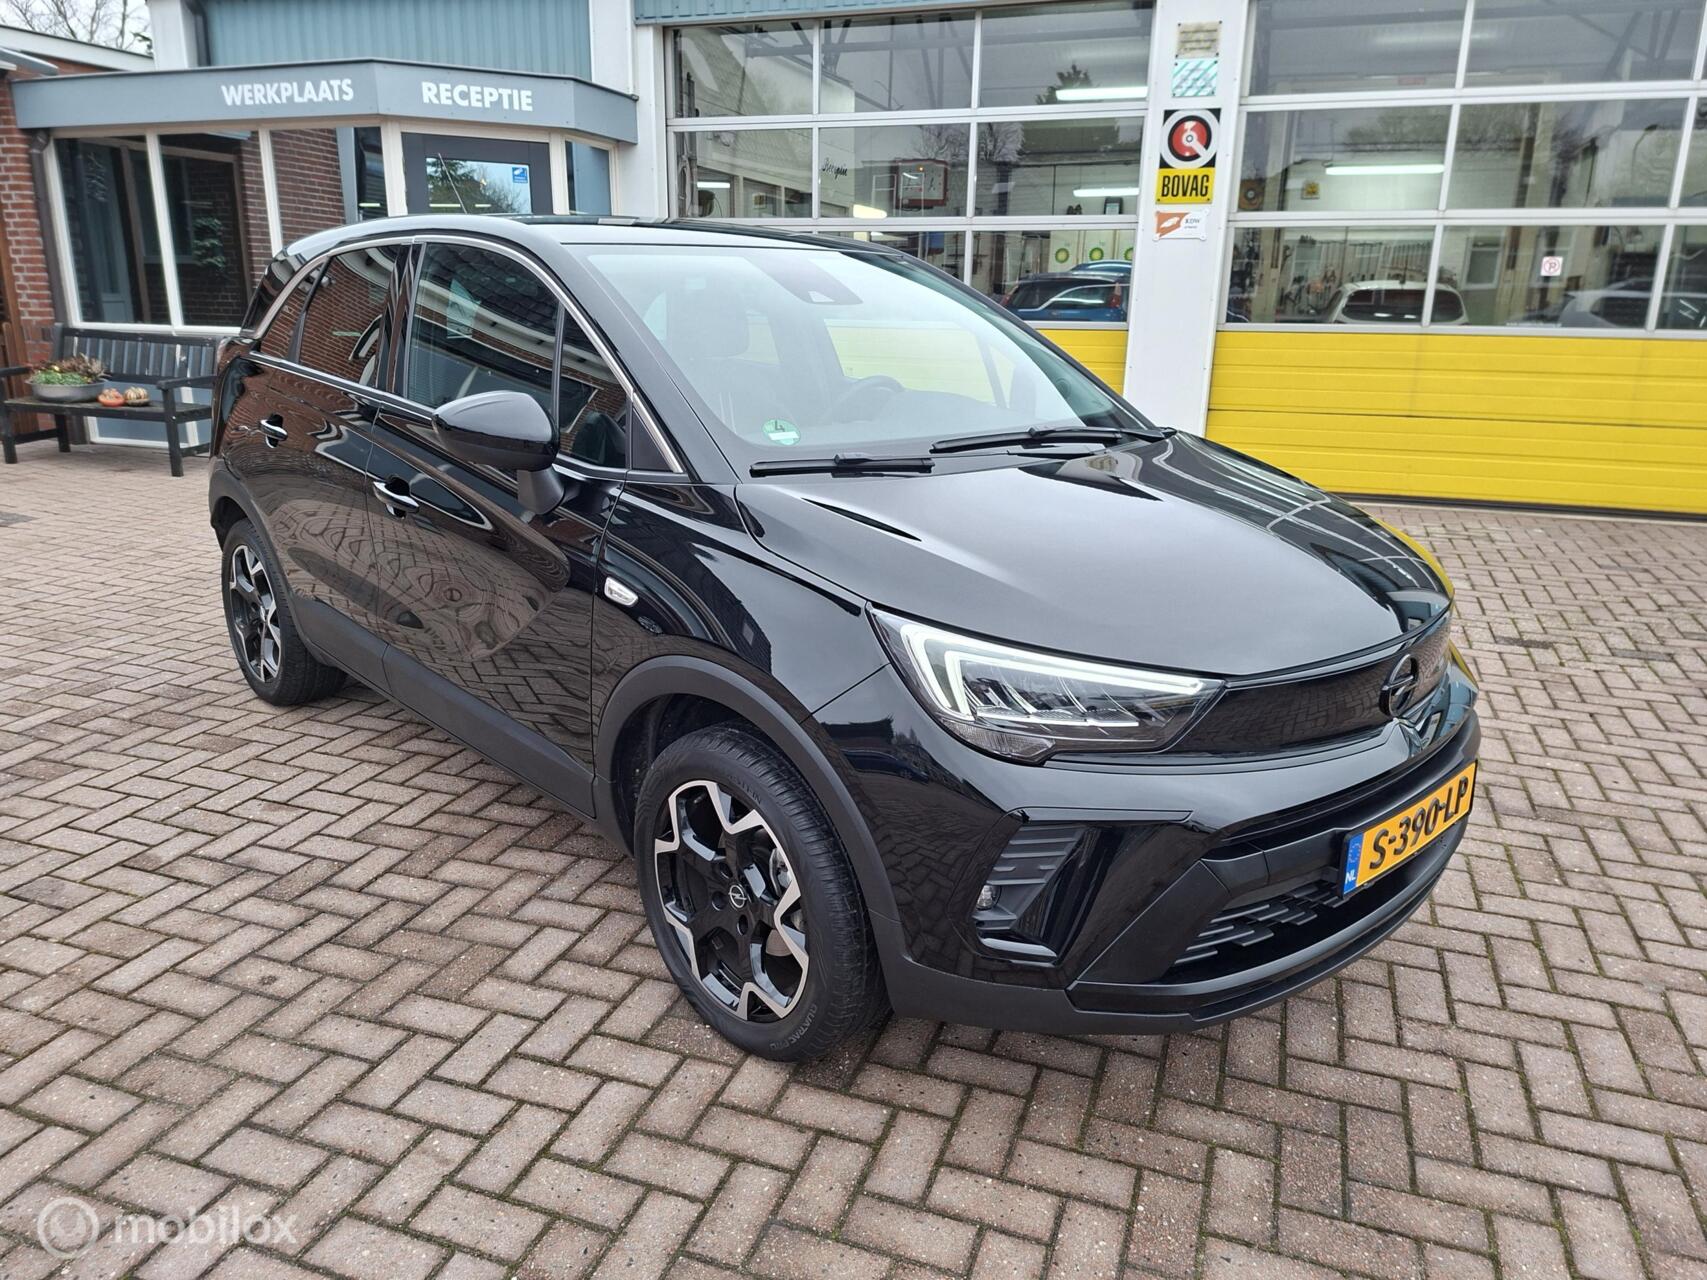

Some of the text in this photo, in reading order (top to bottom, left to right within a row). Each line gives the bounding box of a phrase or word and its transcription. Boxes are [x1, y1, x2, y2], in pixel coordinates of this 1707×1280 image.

[221, 78, 354, 106] WERKPLAATS
[420, 81, 535, 112] RECEPTIE
[1161, 174, 1210, 198] BOVAG
[1369, 776, 1469, 870] S-390-LP
[1345, 869, 1356, 884] NL
